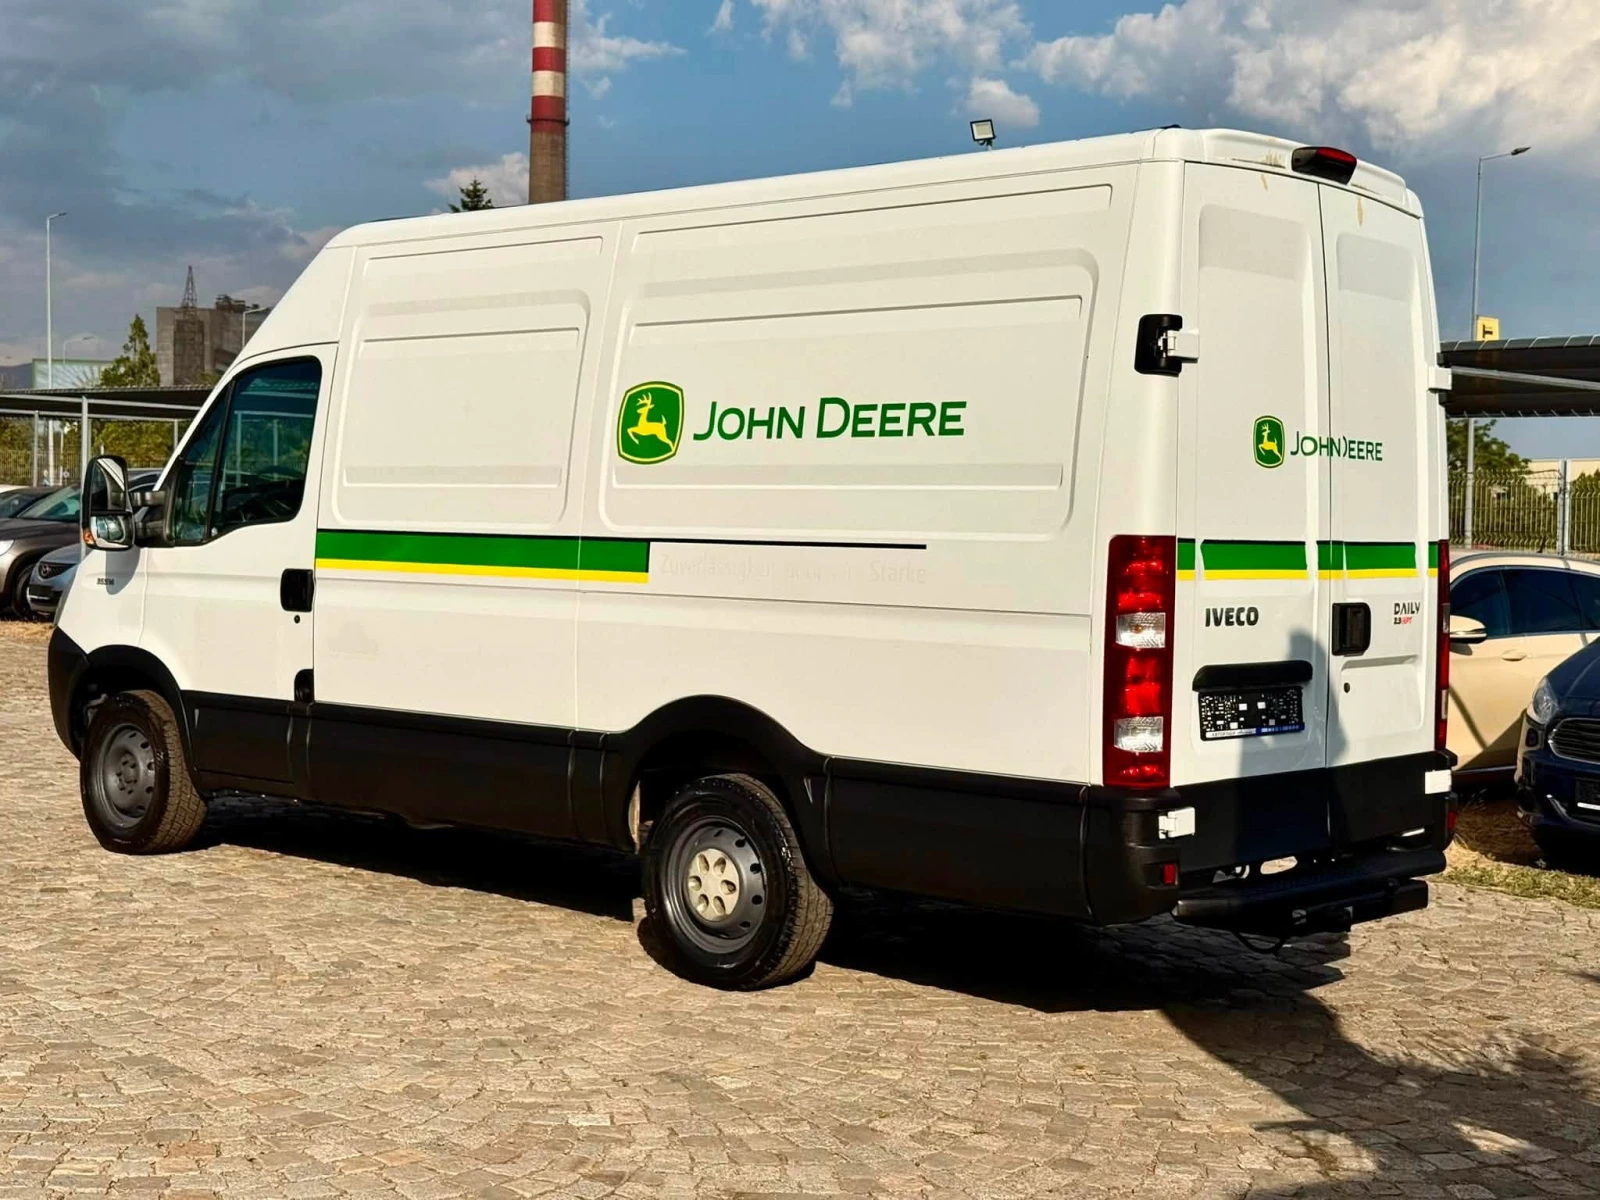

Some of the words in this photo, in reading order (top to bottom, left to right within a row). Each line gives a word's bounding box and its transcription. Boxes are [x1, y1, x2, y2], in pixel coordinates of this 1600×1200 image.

[693, 401, 806, 441] JOHN
[816, 397, 967, 438] DEERE
[1290, 431, 1341, 457] JOHN
[1205, 606, 1259, 627] IVECO
[1393, 601, 1421, 615] DAILY
